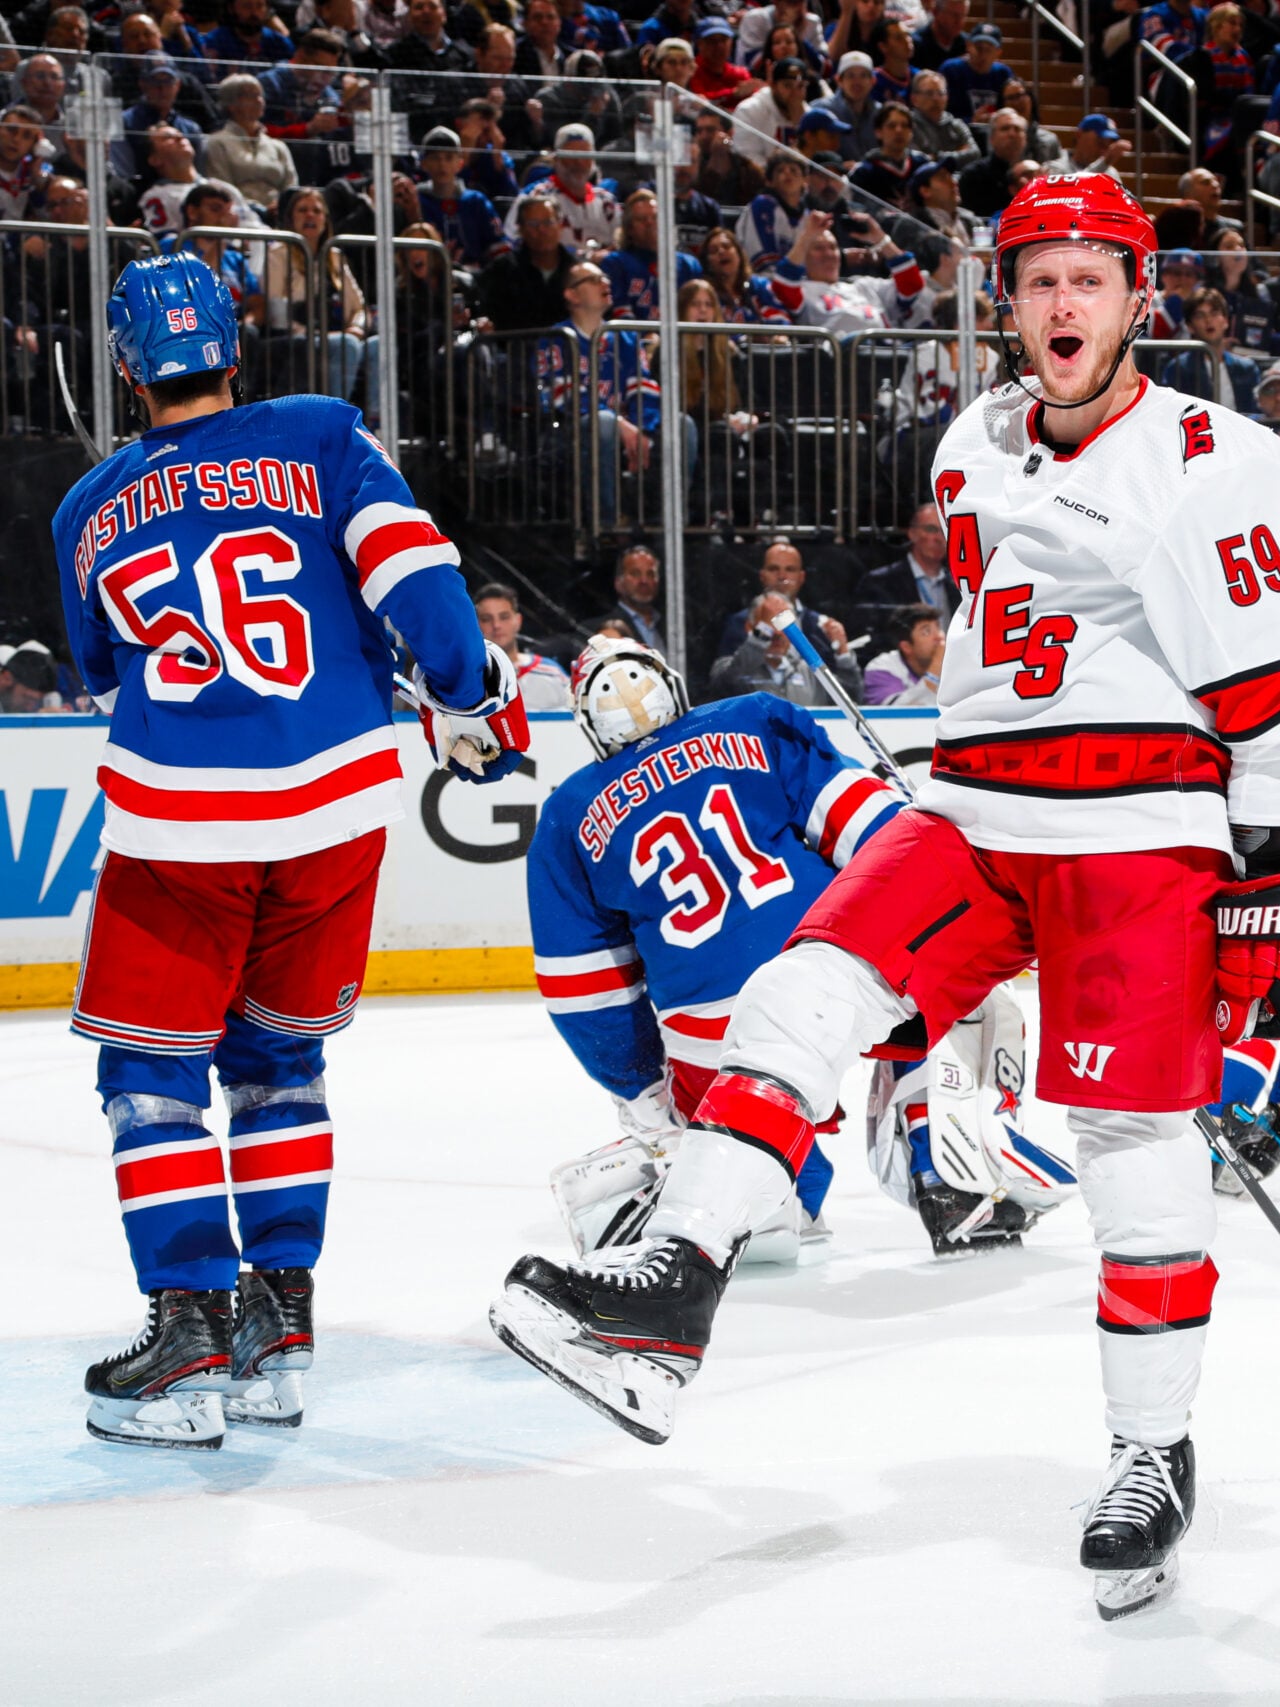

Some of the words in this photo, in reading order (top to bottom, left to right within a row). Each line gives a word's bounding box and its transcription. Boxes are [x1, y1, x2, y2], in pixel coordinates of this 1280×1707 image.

[166, 307, 198, 333] 56
[73, 457, 323, 601] GUSTAFSSON
[1053, 495, 1109, 525] NUCOR
[97, 525, 315, 702] 56
[578, 732, 770, 863] SHESTERKIN
[629, 783, 795, 950] 31
[943, 1067, 962, 1087] 31
